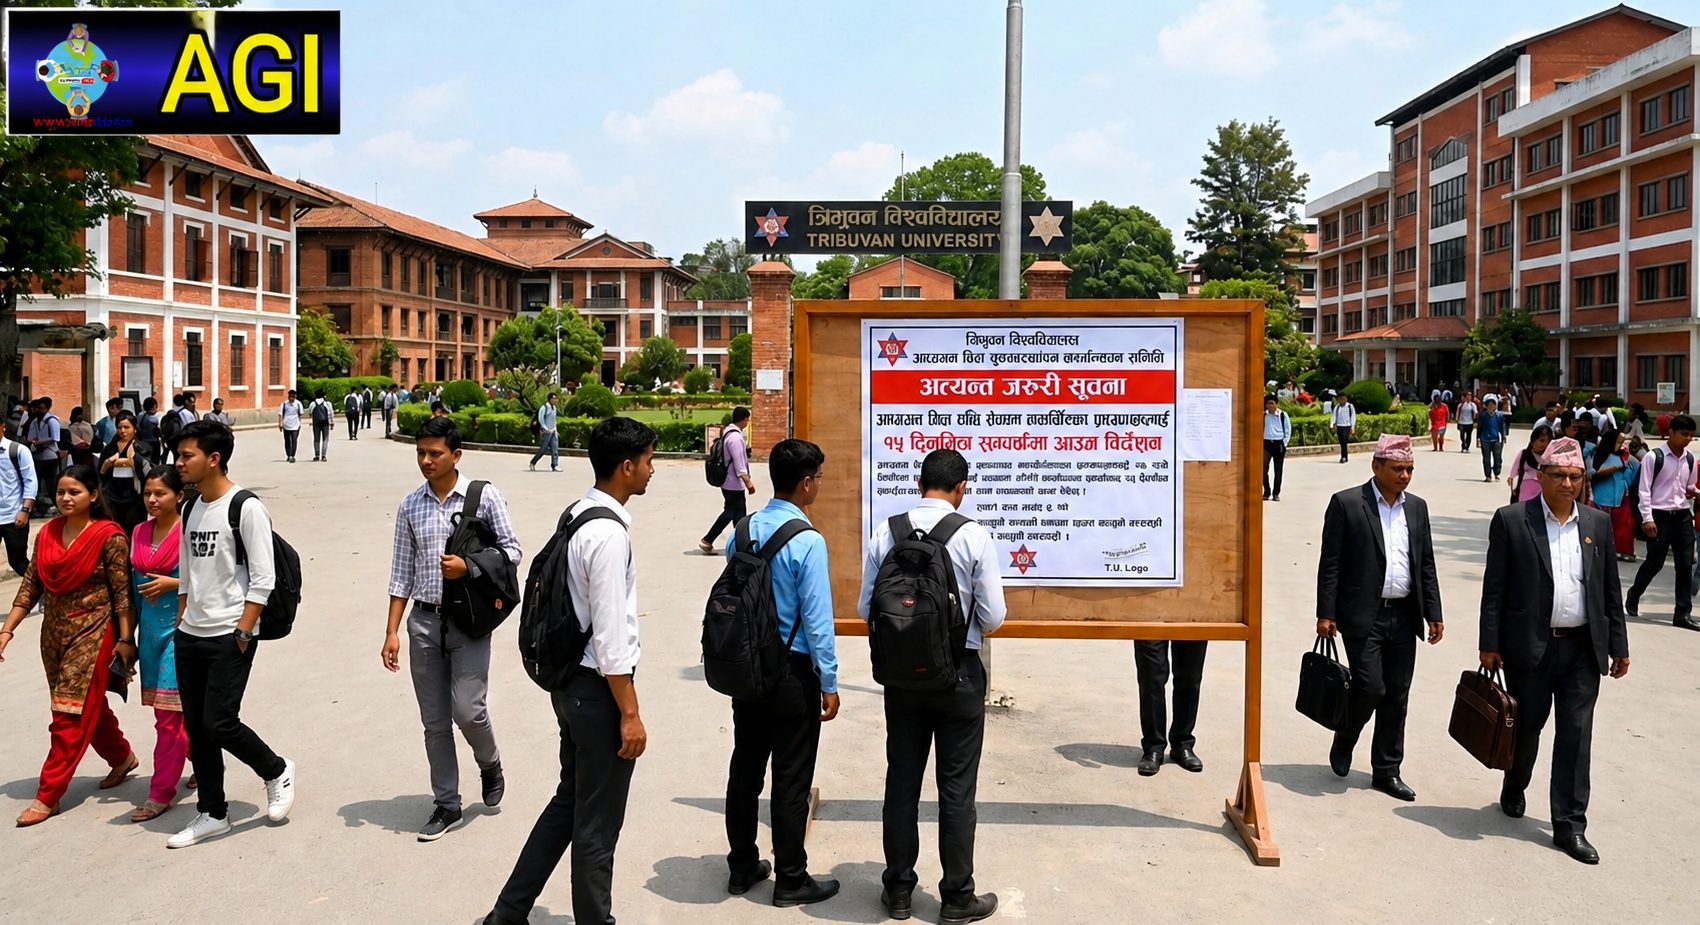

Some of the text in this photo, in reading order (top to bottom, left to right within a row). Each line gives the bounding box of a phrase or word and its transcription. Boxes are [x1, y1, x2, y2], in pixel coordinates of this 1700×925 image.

[807, 233, 895, 248] TRIBUVAN
[919, 378, 995, 396] अत्यन्त
[1104, 563, 1149, 574] T.U. Logo
